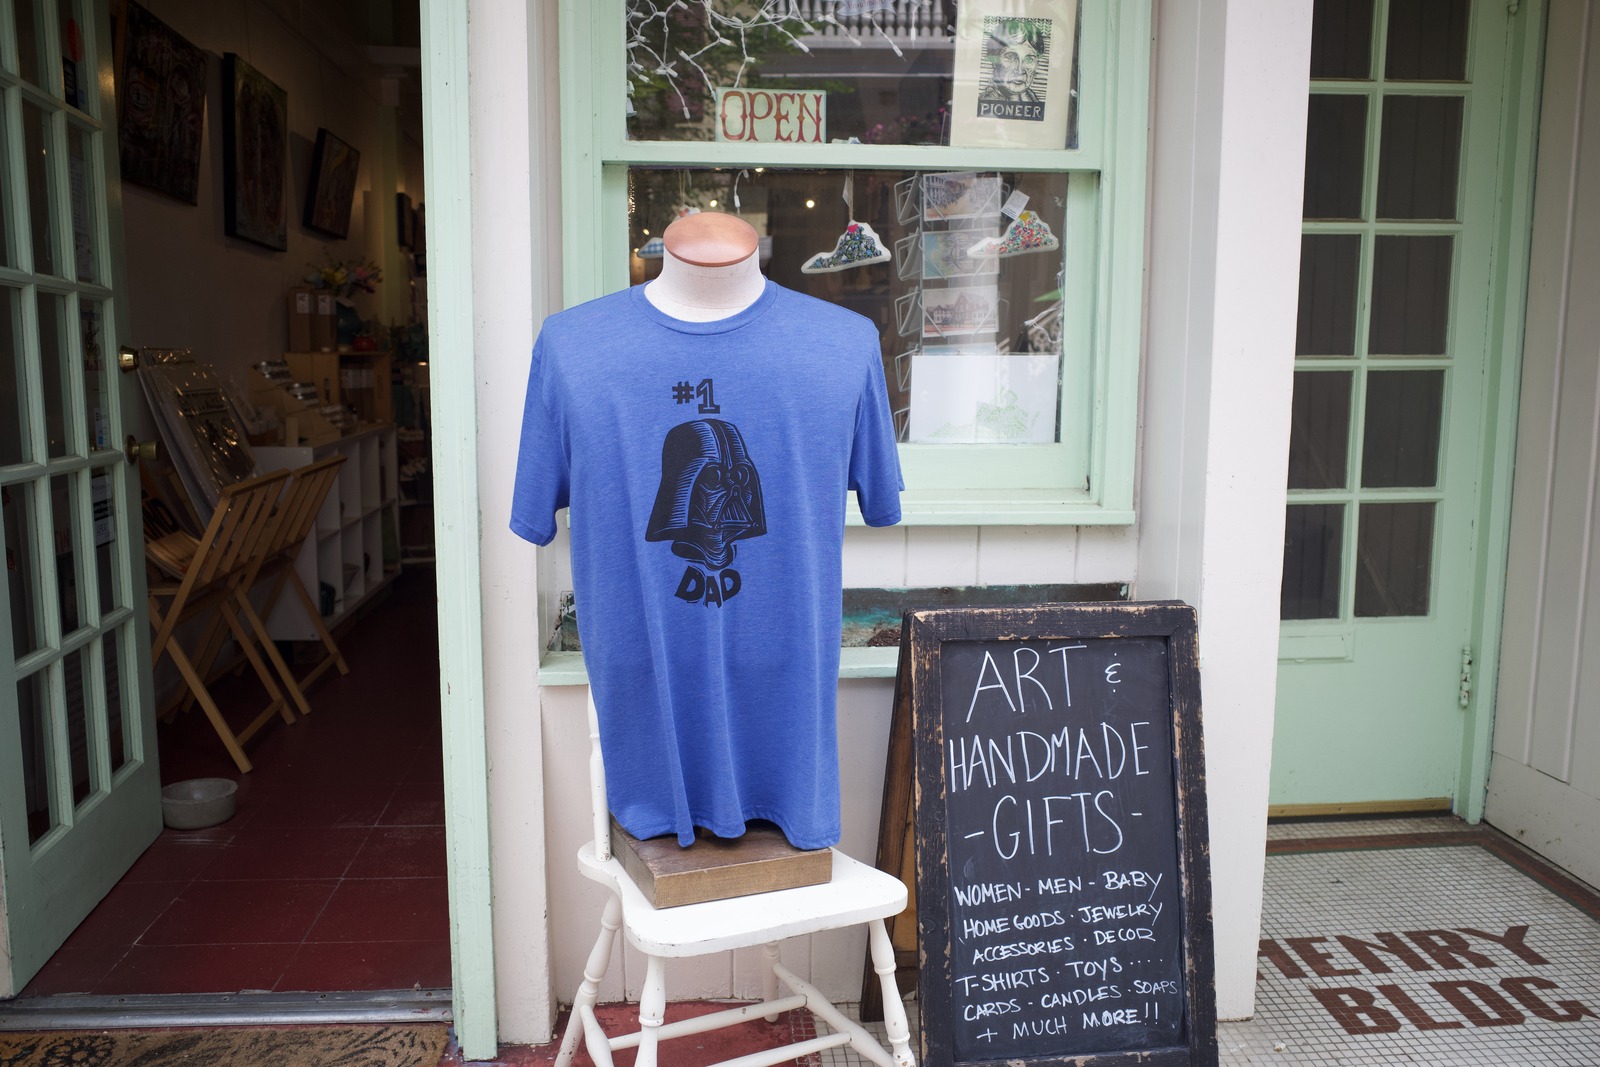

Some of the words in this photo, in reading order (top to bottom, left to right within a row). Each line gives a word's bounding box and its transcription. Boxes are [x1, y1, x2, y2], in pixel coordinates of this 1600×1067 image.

[719, 90, 823, 142] OPEN
[980, 103, 1042, 118] PIONEER
[671, 378, 721, 415] #1
[673, 565, 742, 609] DAD
[965, 645, 1087, 722] ART
[949, 722, 1150, 793] HANDMADE
[1038, 876, 1082, 895] MEN
[1102, 870, 1163, 902] BABY
[1077, 902, 1163, 927] JEWELRY
[972, 936, 1075, 964] ACCESSORIES
[1093, 927, 1156, 946] DECOR
[955, 967, 1050, 997] T-SHIRTS
[1064, 956, 1123, 981] TOYS
[963, 999, 1022, 1022] CARDS
[1040, 984, 1122, 1009] CANDLES
[1133, 980, 1179, 995] SOAPS
[1309, 976, 1600, 1036] BLDG
[1012, 1015, 1068, 1040] MUCH
